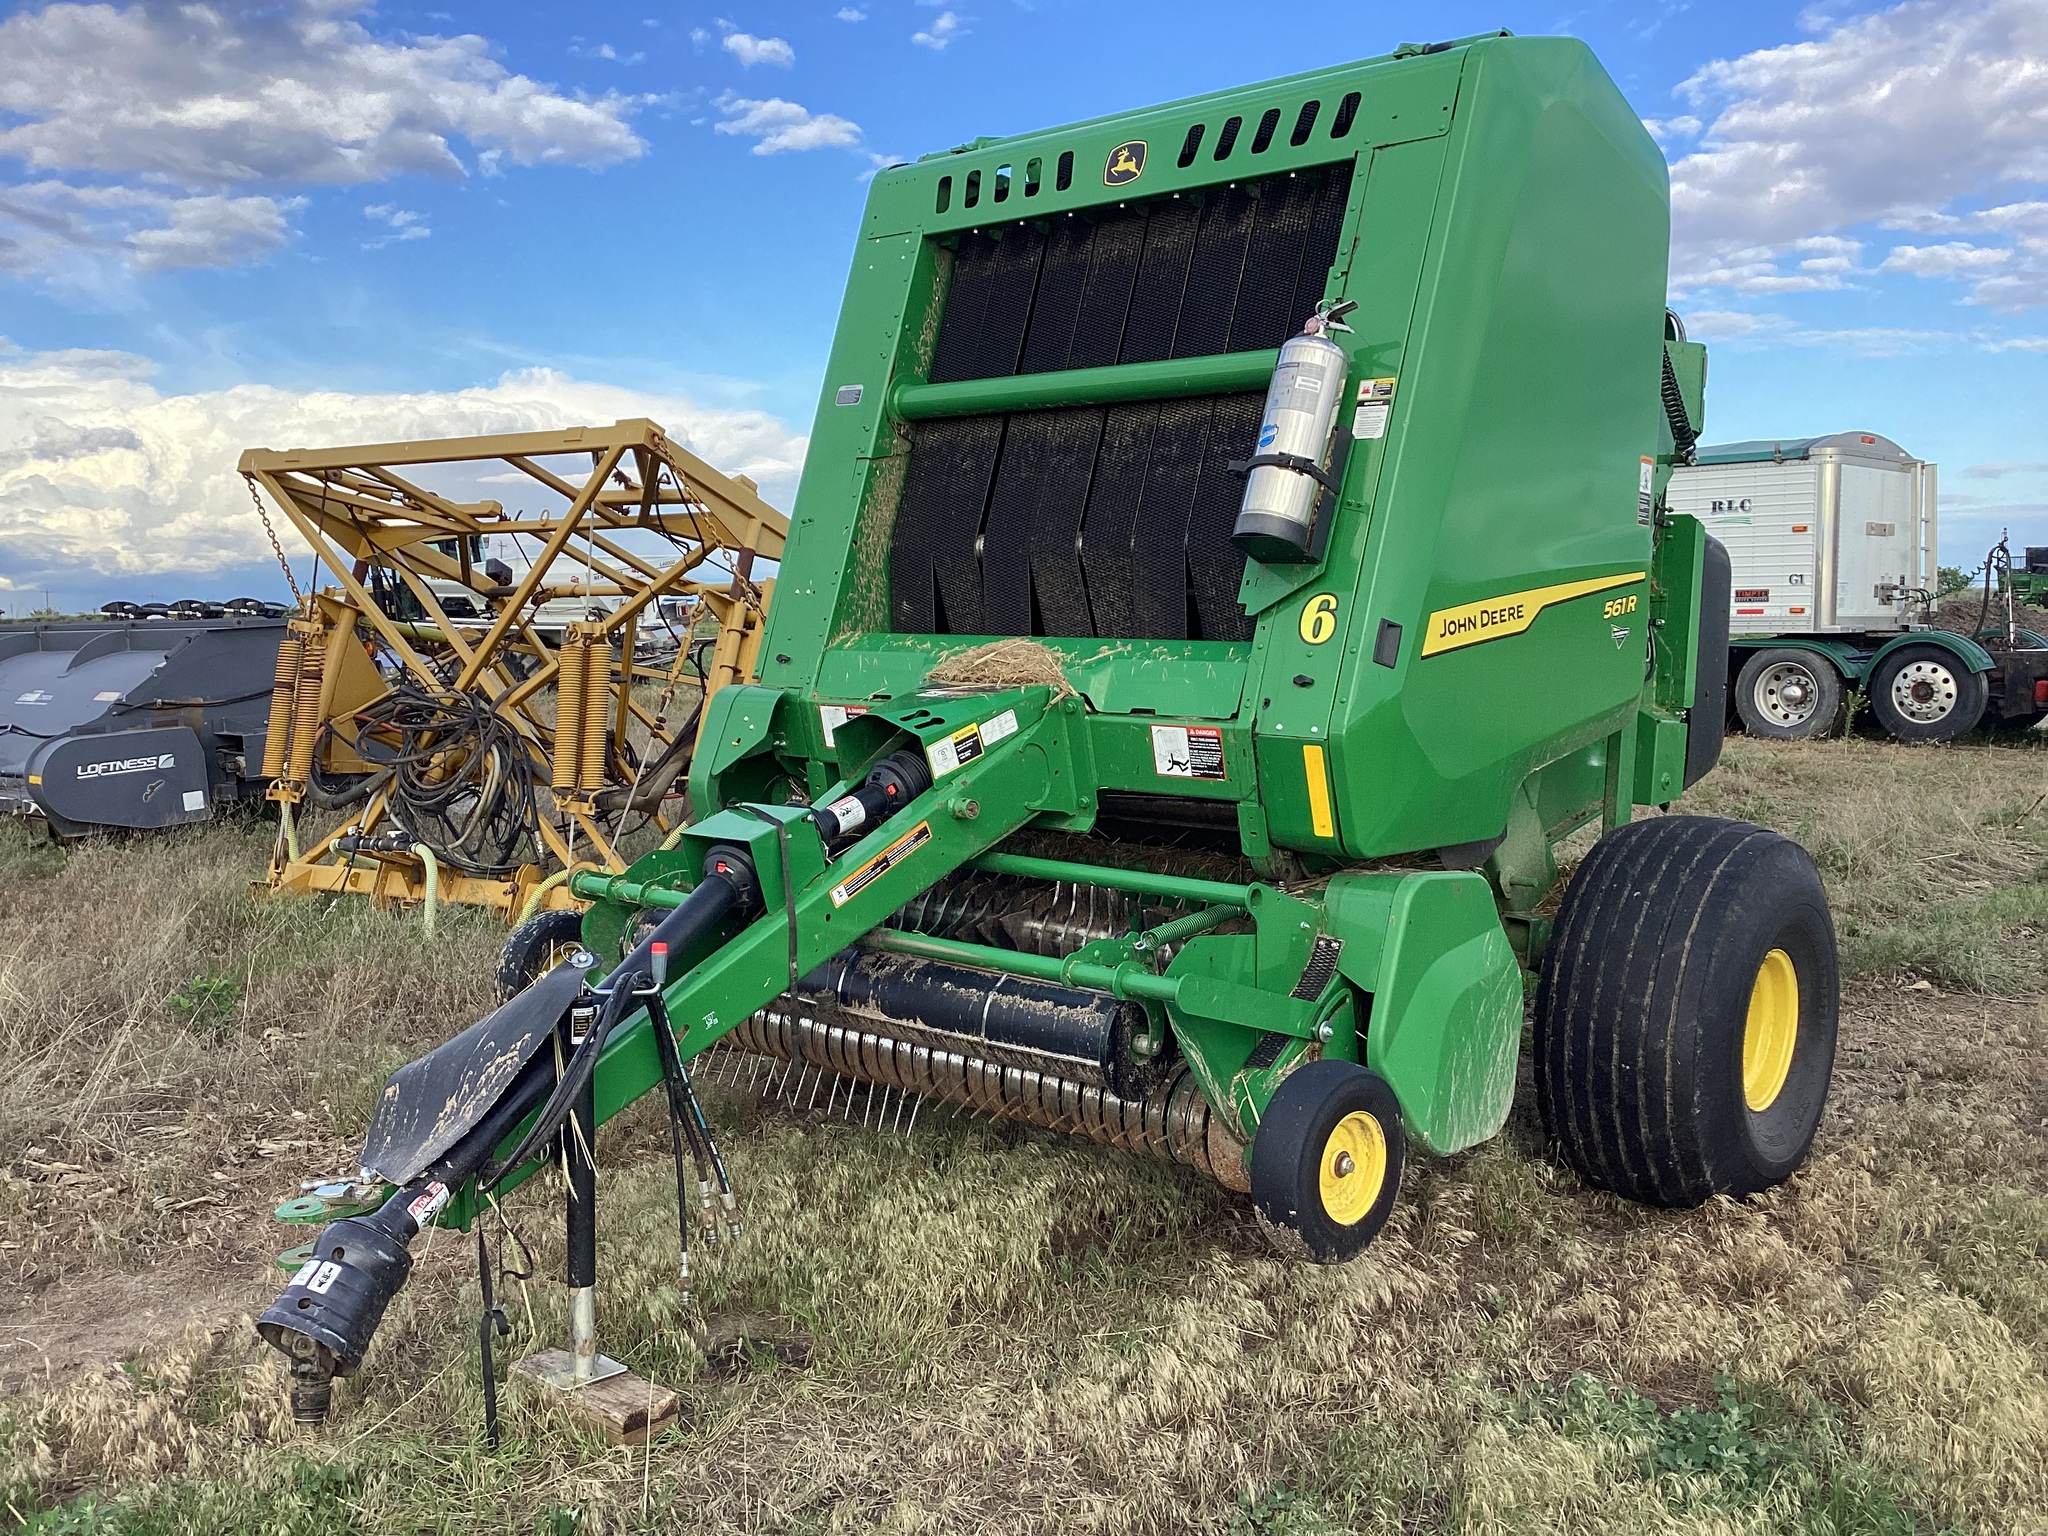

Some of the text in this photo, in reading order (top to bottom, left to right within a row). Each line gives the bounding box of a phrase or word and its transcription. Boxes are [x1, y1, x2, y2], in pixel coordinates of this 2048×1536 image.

[1711, 499, 1752, 514] RLC
[1788, 574, 1804, 585] G1
[1298, 592, 1339, 646] 6
[1439, 604, 1524, 638] JOHN DEERE
[76, 756, 158, 776] LOFTNESS
